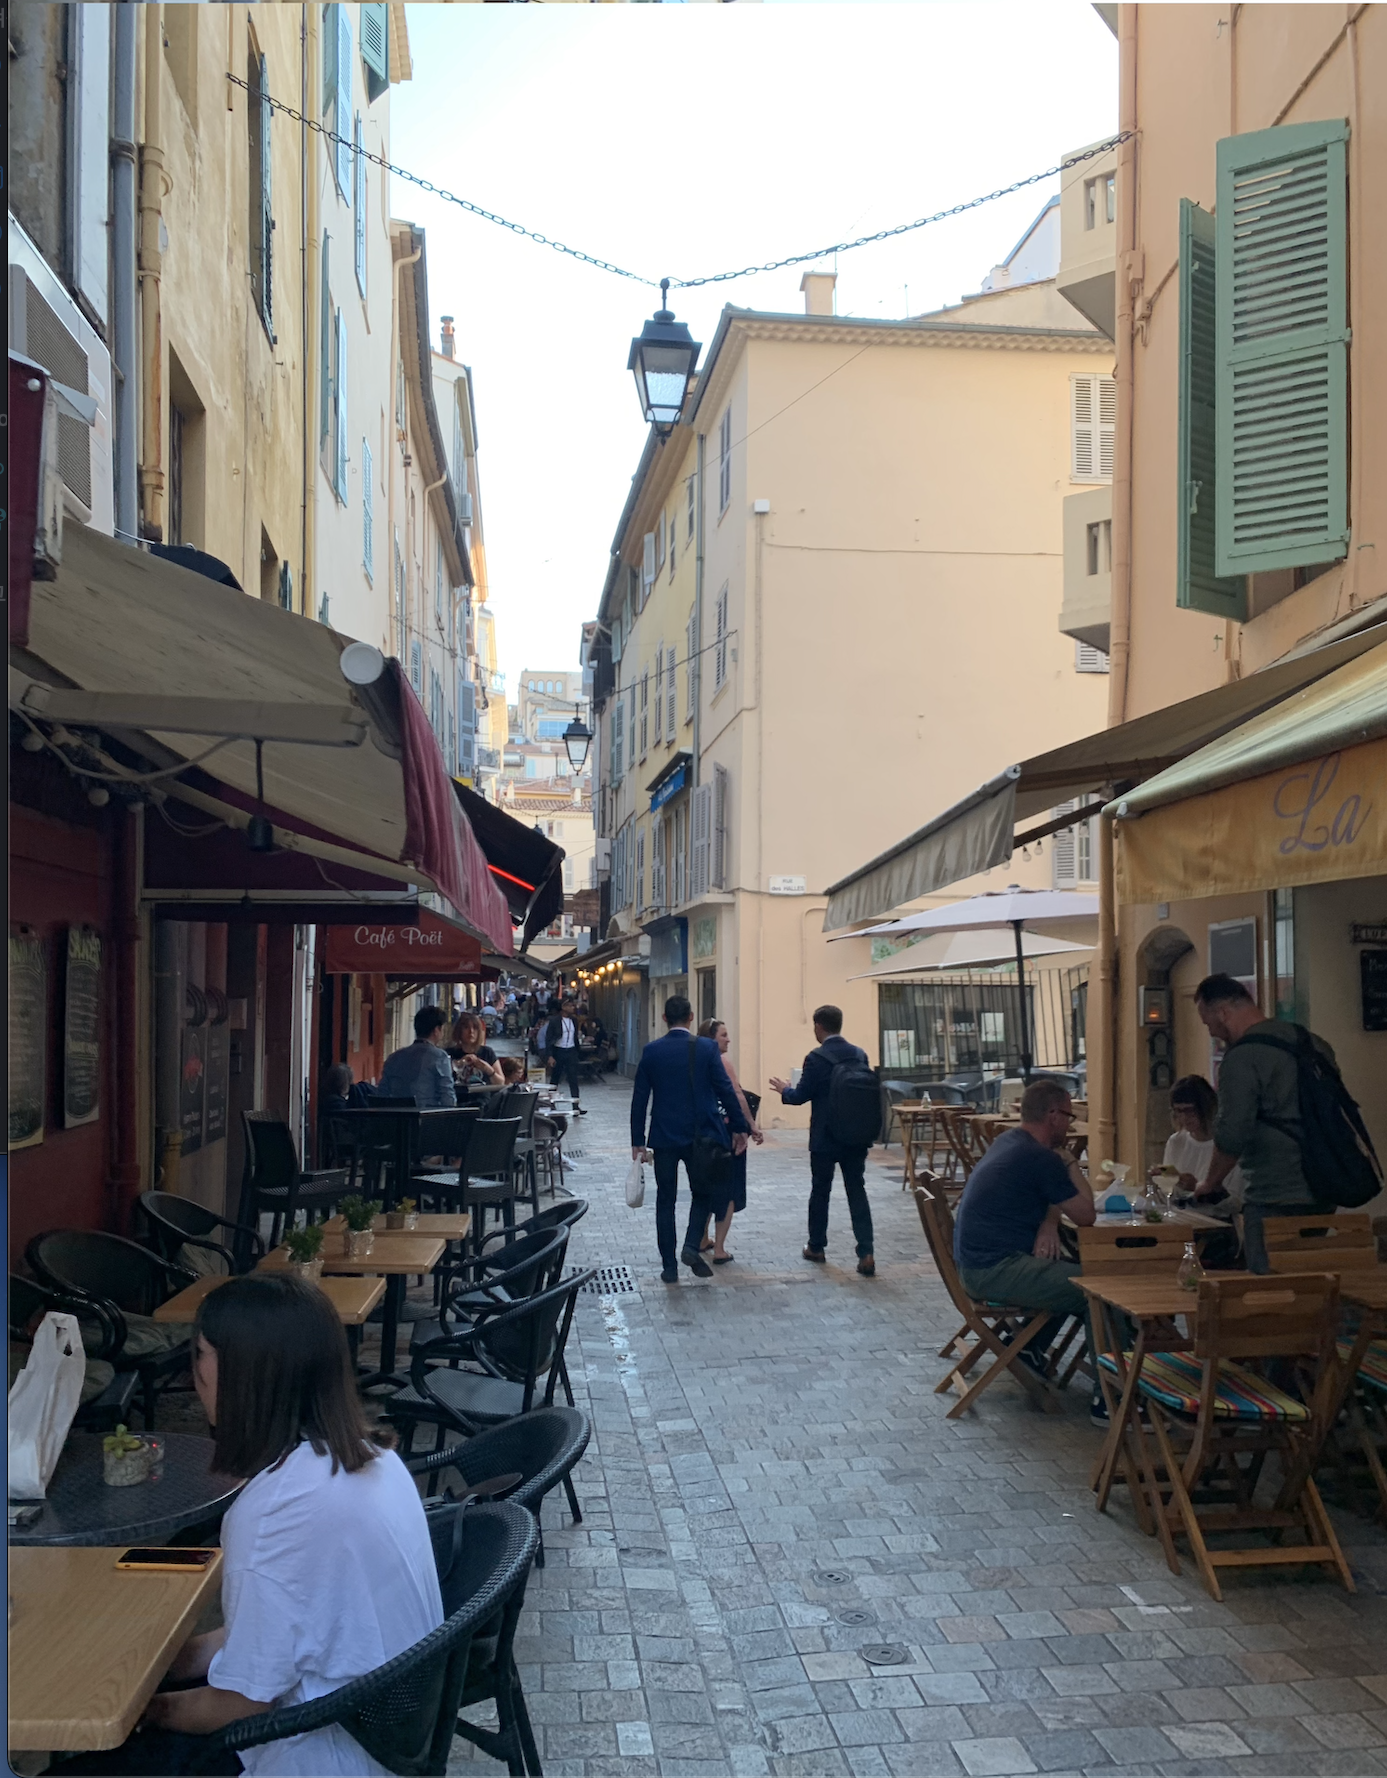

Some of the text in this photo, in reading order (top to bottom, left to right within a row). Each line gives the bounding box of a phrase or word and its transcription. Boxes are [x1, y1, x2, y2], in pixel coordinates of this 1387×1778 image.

[1273, 750, 1374, 855] La
[354, 925, 444, 949] Café Poët
